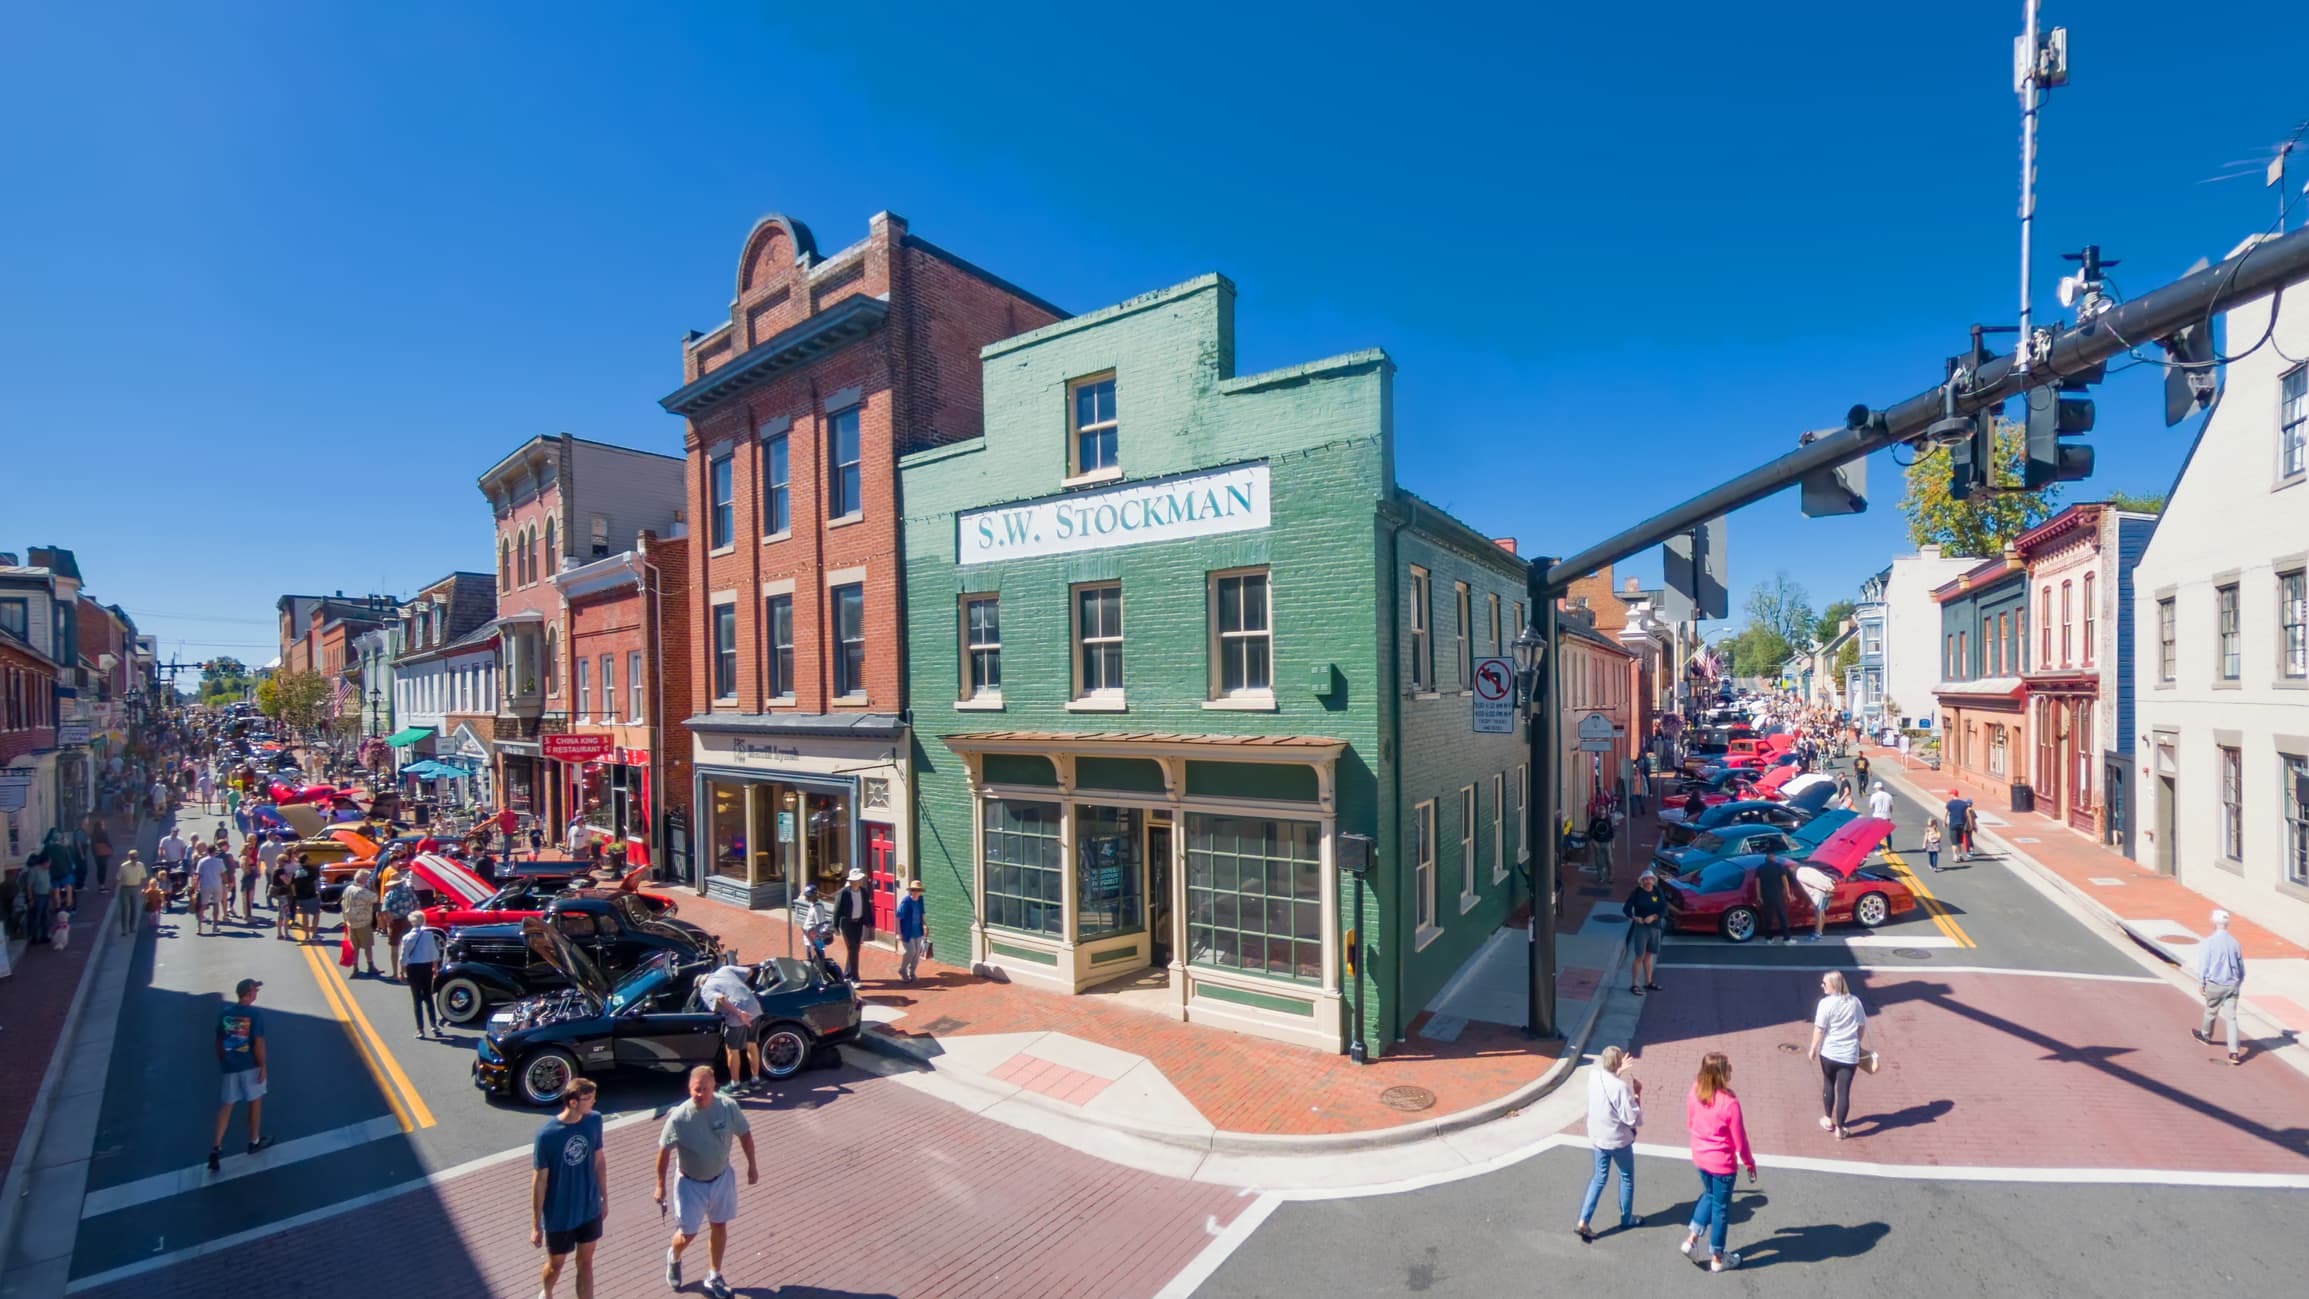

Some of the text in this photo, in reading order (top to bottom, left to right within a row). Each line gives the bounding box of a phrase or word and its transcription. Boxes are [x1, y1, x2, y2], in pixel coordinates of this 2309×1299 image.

[977, 482, 1253, 549] S.W. STOCKMAN
[555, 737, 599, 745] CHINA KING
